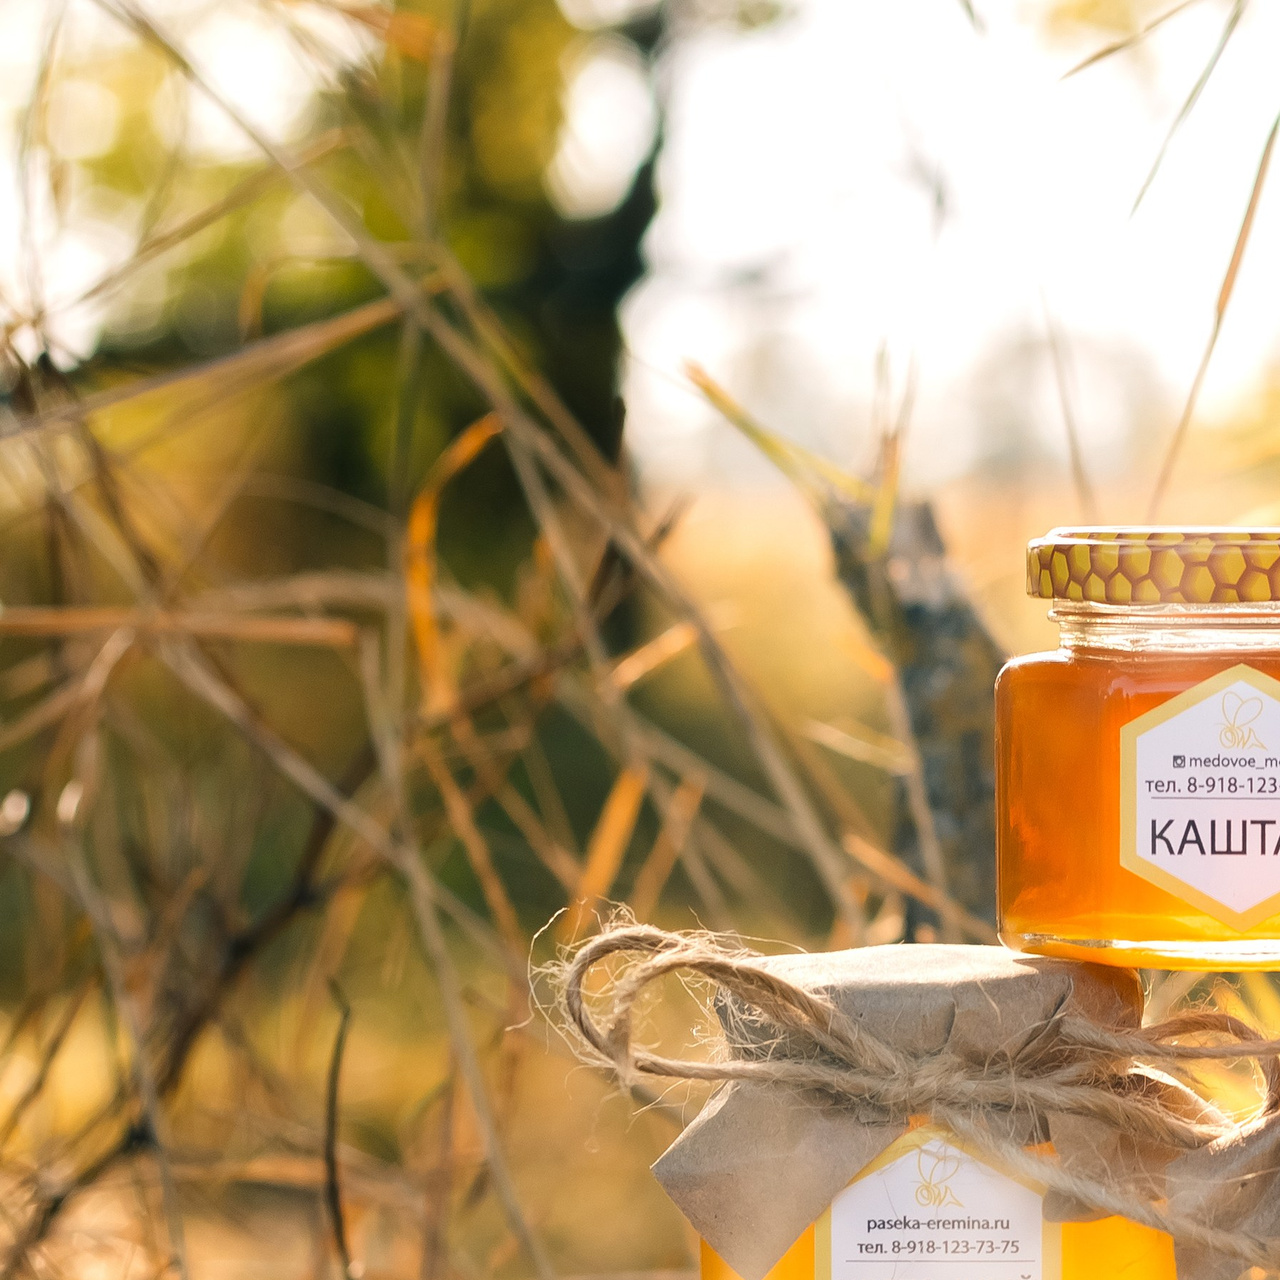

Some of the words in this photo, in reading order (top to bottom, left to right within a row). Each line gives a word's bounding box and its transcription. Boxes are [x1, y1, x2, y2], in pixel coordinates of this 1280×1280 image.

[1145, 779, 1182, 793] тел.
[867, 1216, 1010, 1232] paseka-eremina.ru
[857, 1242, 887, 1254] тел.
[892, 1240, 1019, 1254] 8-918-123-73-75
